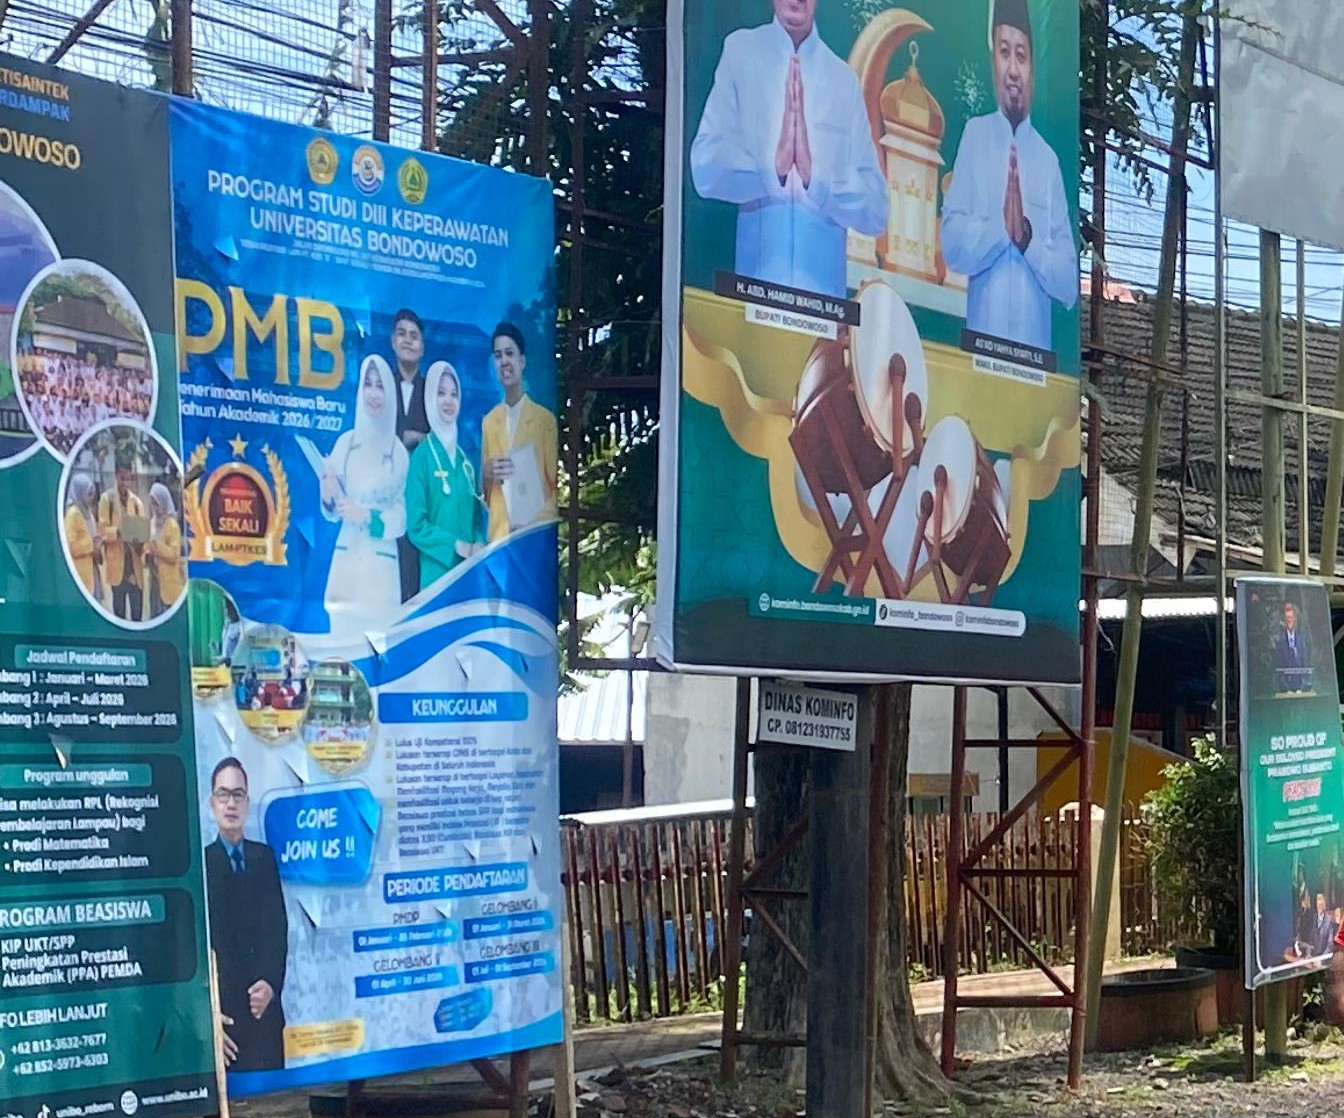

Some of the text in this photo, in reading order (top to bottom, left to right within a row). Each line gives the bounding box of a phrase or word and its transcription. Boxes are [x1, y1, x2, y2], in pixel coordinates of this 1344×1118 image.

[0, 127, 81, 170] OWOSO
[208, 169, 509, 248] PROGRAM STUDI DIII KEPERAWATAN
[250, 207, 363, 249] UNIVERSITAS
[367, 230, 477, 268] BONDOWOSO
[767, 288, 795, 306] HAMID
[796, 295, 825, 314] WAHID,
[755, 309, 829, 334] BUPATI BONDOWOSO
[175, 277, 345, 391] PMB
[179, 383, 346, 413] enerimaan Mahasiswa Baru
[218, 404, 280, 425] Akademik
[224, 498, 253, 514] BAIK
[218, 517, 260, 533] SEKALI
[26, 650, 136, 667] Jadwal Pendaftaran
[0, 669, 31, 687] bang
[45, 671, 85, 685] Januari
[95, 673, 124, 686] Maret
[0, 691, 32, 708] bang
[45, 691, 71, 708] April
[81, 692, 100, 705] Juli
[411, 698, 498, 716] KEUNGGULAN
[765, 690, 855, 721] DINAS KOMINFO
[0, 711, 32, 729] bang
[46, 711, 89, 728] Agustus
[98, 713, 153, 728] September
[767, 717, 783, 734] CP.
[1270, 731, 1327, 751] SO PROUD OF
[24, 768, 129, 786] Program unggulan
[19, 793, 159, 811] melakukan RPL (Rekognisi
[73, 813, 120, 832] Lampau)
[122, 814, 146, 832] bagi
[296, 807, 338, 829] COME
[12, 836, 110, 852] Prodi Matematika
[281, 840, 317, 863] JOIN
[321, 838, 341, 860] US
[13, 854, 149, 874] Prodi Kependidikan Islam
[387, 869, 526, 897] PERIODE PENDAFTARAN
[75, 900, 152, 923] BEASISWA
[481, 899, 532, 916] GELOMBANG
[1, 934, 76, 954] KIP UKT/SPP
[480, 942, 531, 959] GELOMBANG
[2, 946, 129, 972] Peningkatan Prestasi
[373, 955, 432, 973] GELOMBANG
[2, 962, 143, 988] Akademik (PPA) PEMDA
[19, 1007, 58, 1027] LEBIH
[58, 1003, 108, 1023] LANJUT
[10, 1041, 31, 1055] +62
[13, 1061, 33, 1075] +62
